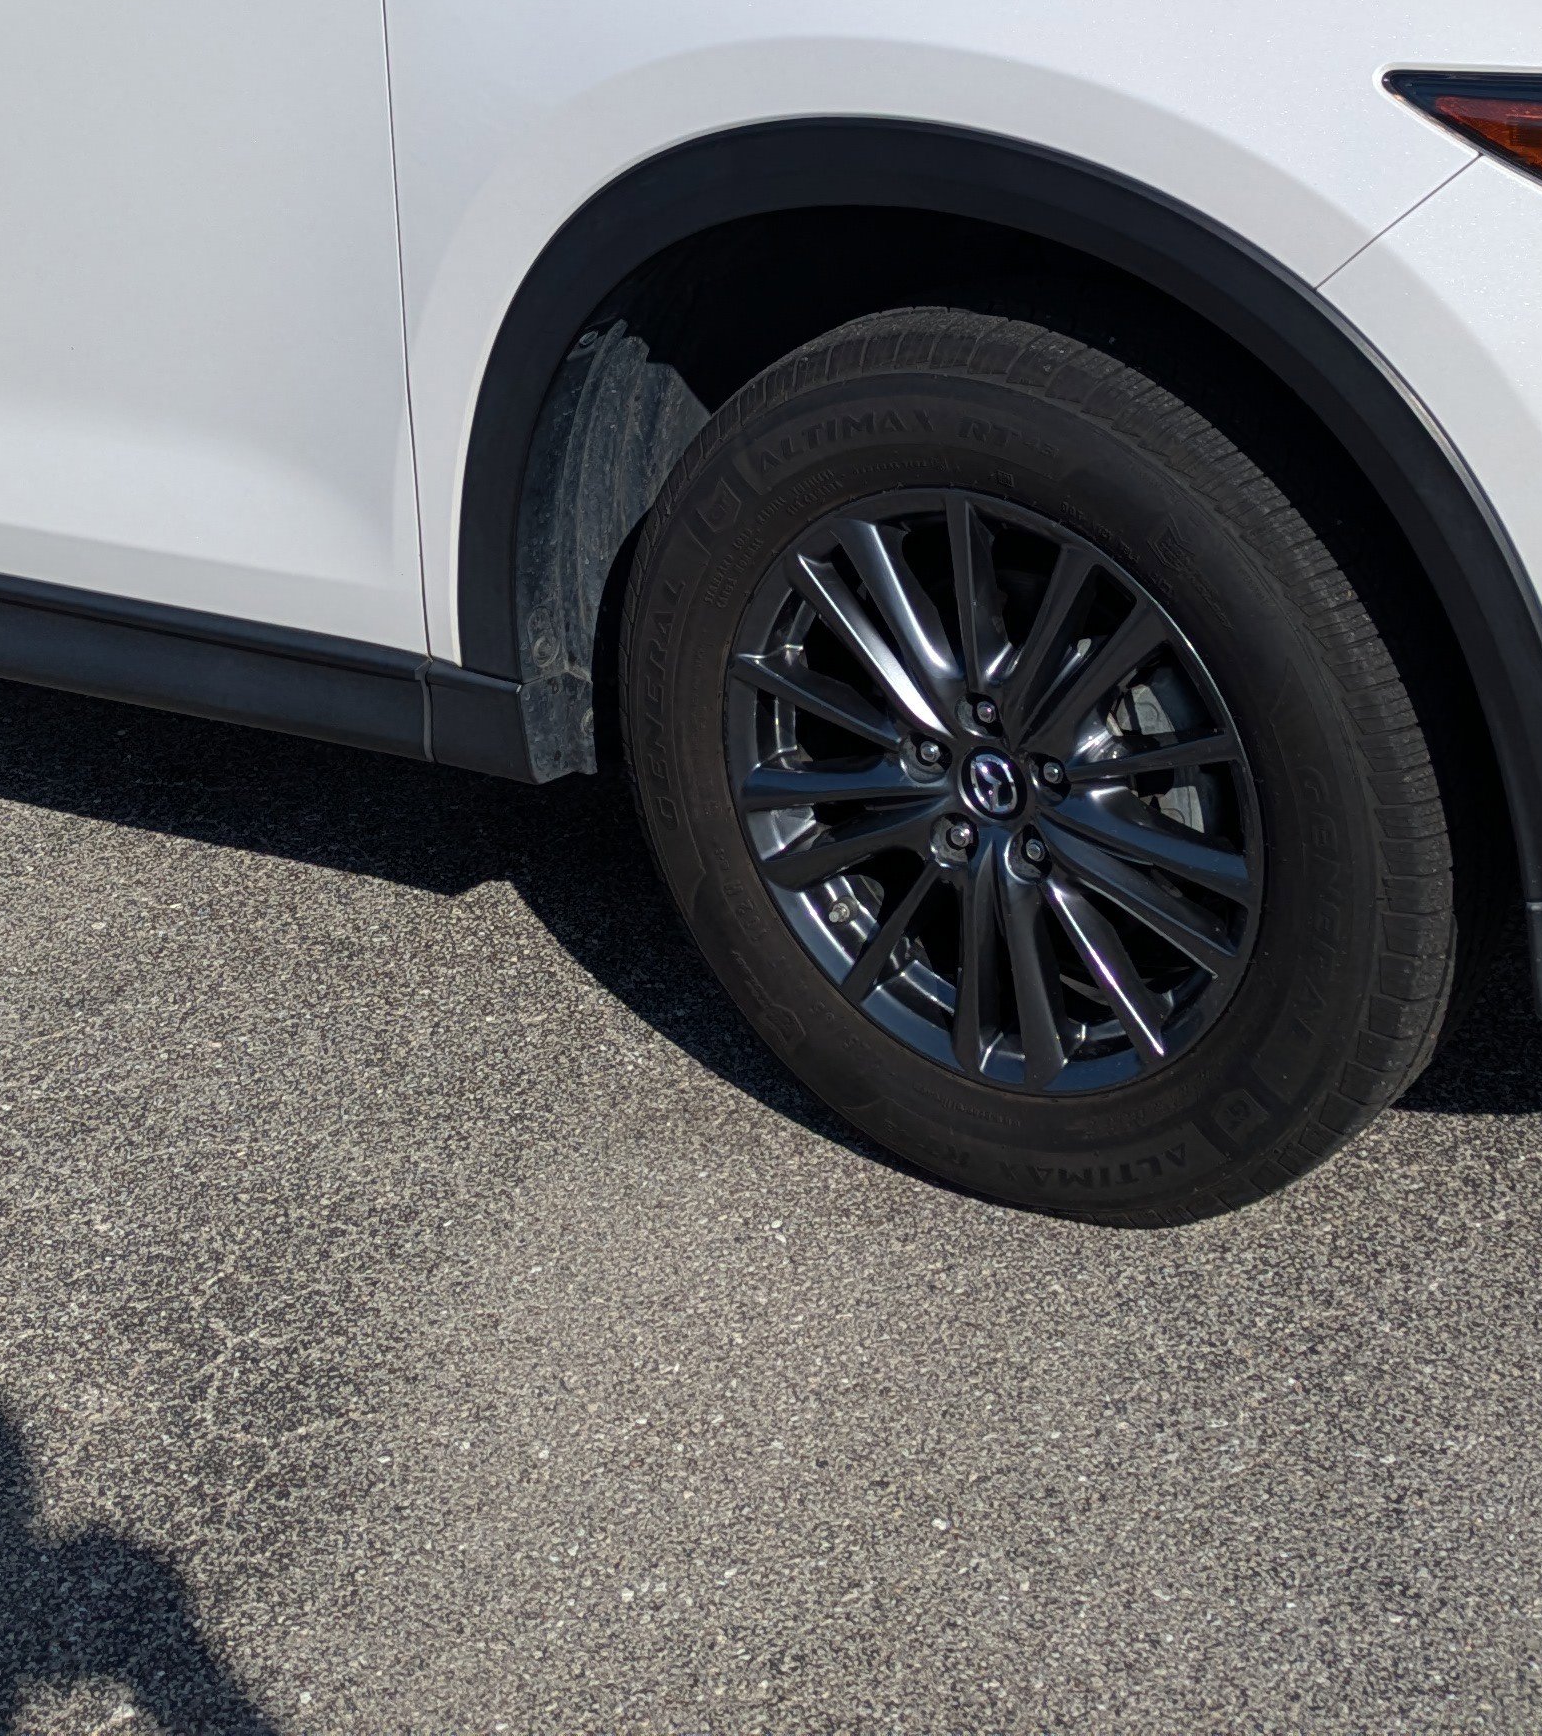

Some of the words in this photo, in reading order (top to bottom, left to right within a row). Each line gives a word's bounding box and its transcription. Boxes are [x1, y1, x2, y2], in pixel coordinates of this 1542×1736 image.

[758, 407, 938, 472] ALTIMAX
[643, 579, 686, 832] GENERAL
[996, 1141, 1188, 1189] ALTIMAX
